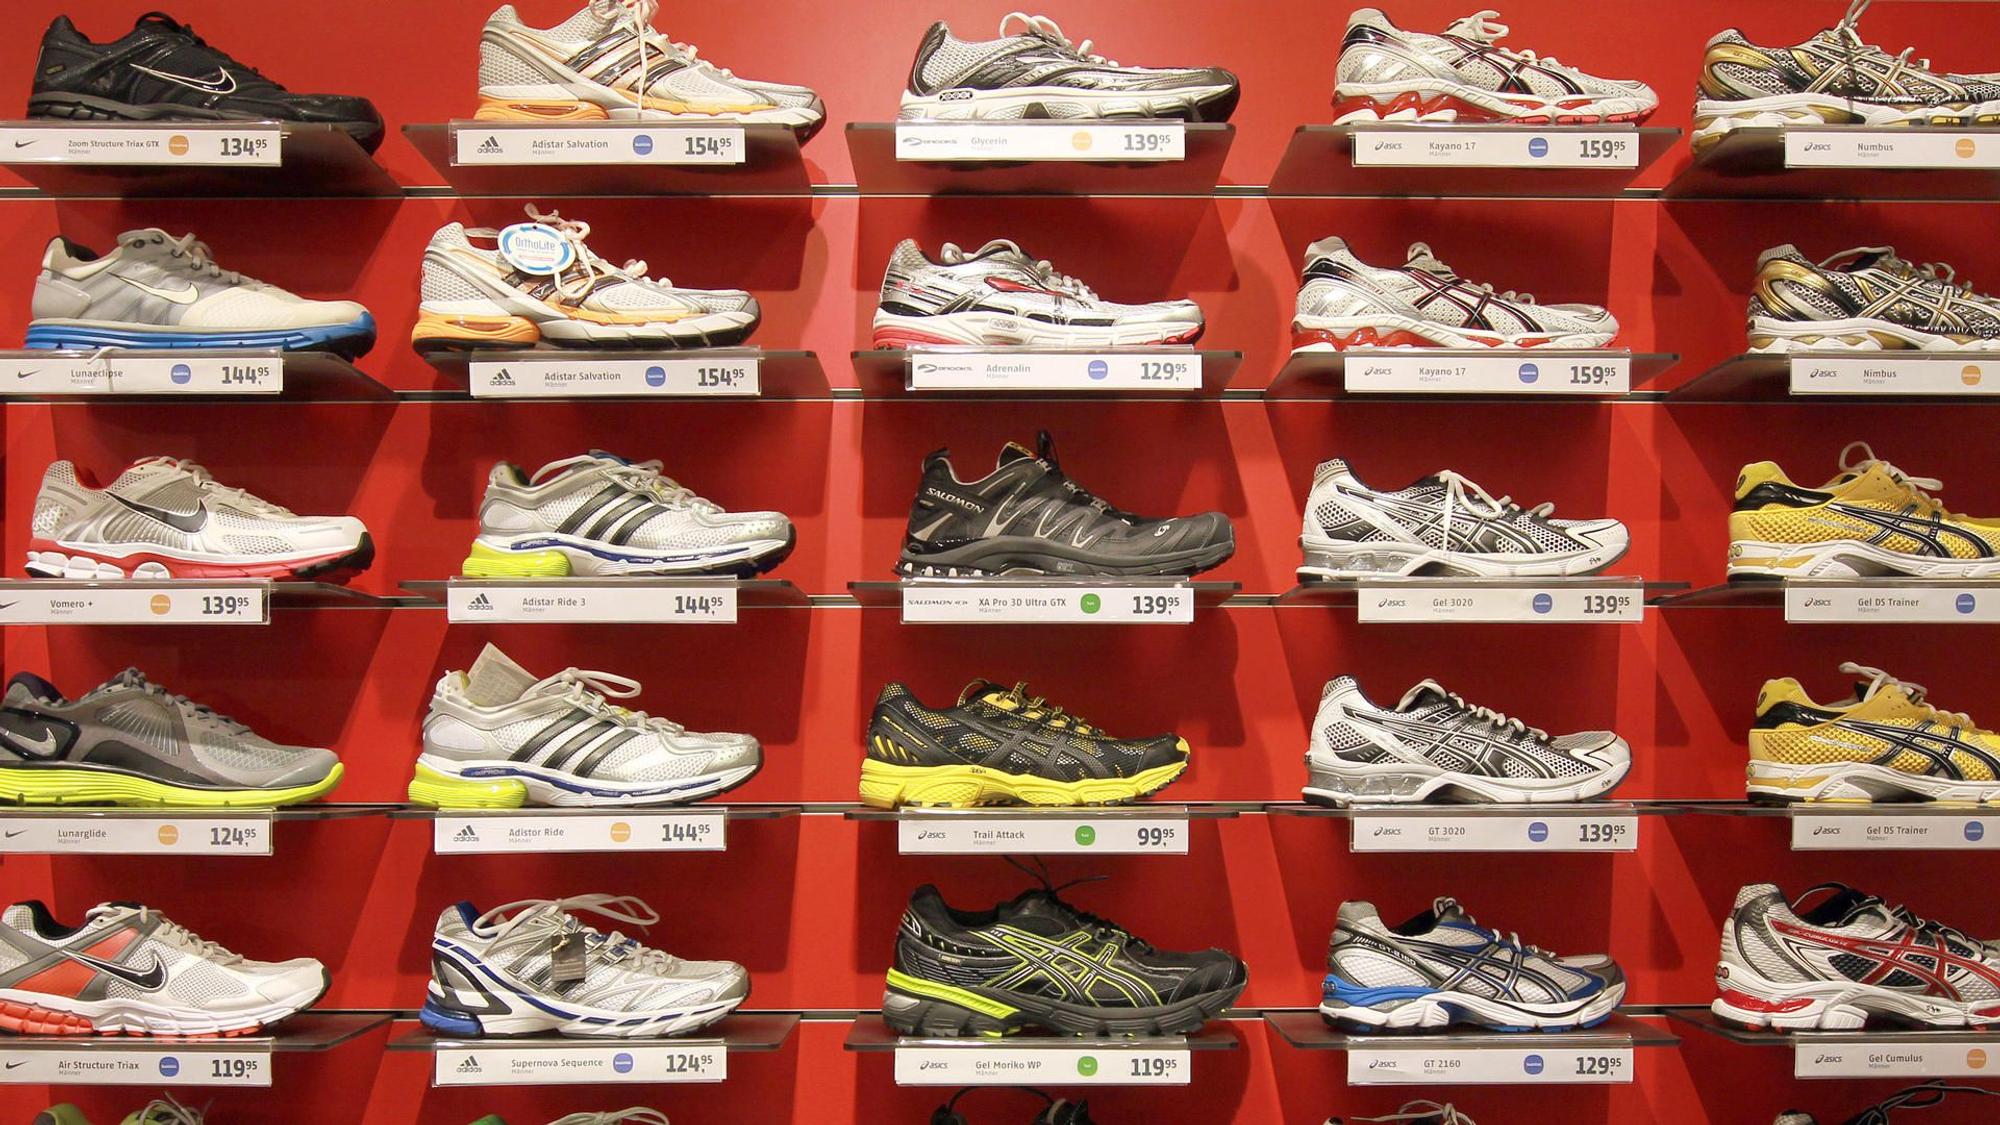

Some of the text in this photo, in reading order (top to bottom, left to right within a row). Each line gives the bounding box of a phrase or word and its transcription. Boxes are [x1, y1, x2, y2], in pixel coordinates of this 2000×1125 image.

[68, 139, 89, 148] Zoom
[90, 139, 124, 148] Structure
[126, 139, 144, 148] Triax
[145, 139, 160, 148] GTX
[531, 139, 609, 150] Adistar Salvation
[970, 136, 1008, 147] Glycerin
[1429, 141, 1476, 152] Kayano 17
[477, 146, 504, 154] adidas
[1857, 142, 1894, 152] Numbus
[70, 368, 124, 379] Lunaeclipse
[985, 364, 1032, 373] Adrenalin
[1418, 367, 1466, 378] Kayano 17
[544, 371, 621, 381] Adistar Salvation
[1863, 369, 1897, 379] Nimbus
[926, 487, 985, 514] SALOMON
[50, 599, 85, 609] Vomero
[467, 603, 494, 611] adidas
[522, 597, 587, 607] Adistar Ride 3
[978, 597, 1067, 607] XA Pro 3D Ultra GTX
[1432, 598, 1474, 608] Gel 3020
[1858, 597, 1920, 607] Gel DS Trainer
[58, 828, 107, 839] Lunarglide
[508, 827, 565, 837] Adistor Ride
[973, 829, 1025, 840] Trail Attack
[1428, 827, 1466, 836] GT 3020
[1866, 826, 1928, 835] Gel DS Trainer
[453, 835, 480, 843] adidas
[511, 1058, 604, 1069] Supernova Sequence
[1868, 1054, 1924, 1063] Gel Cumulus
[58, 1060, 140, 1070] Air Structure Triax
[975, 1060, 1042, 1070] Gel Moriko WP
[1423, 1059, 1461, 1069] GT 2160
